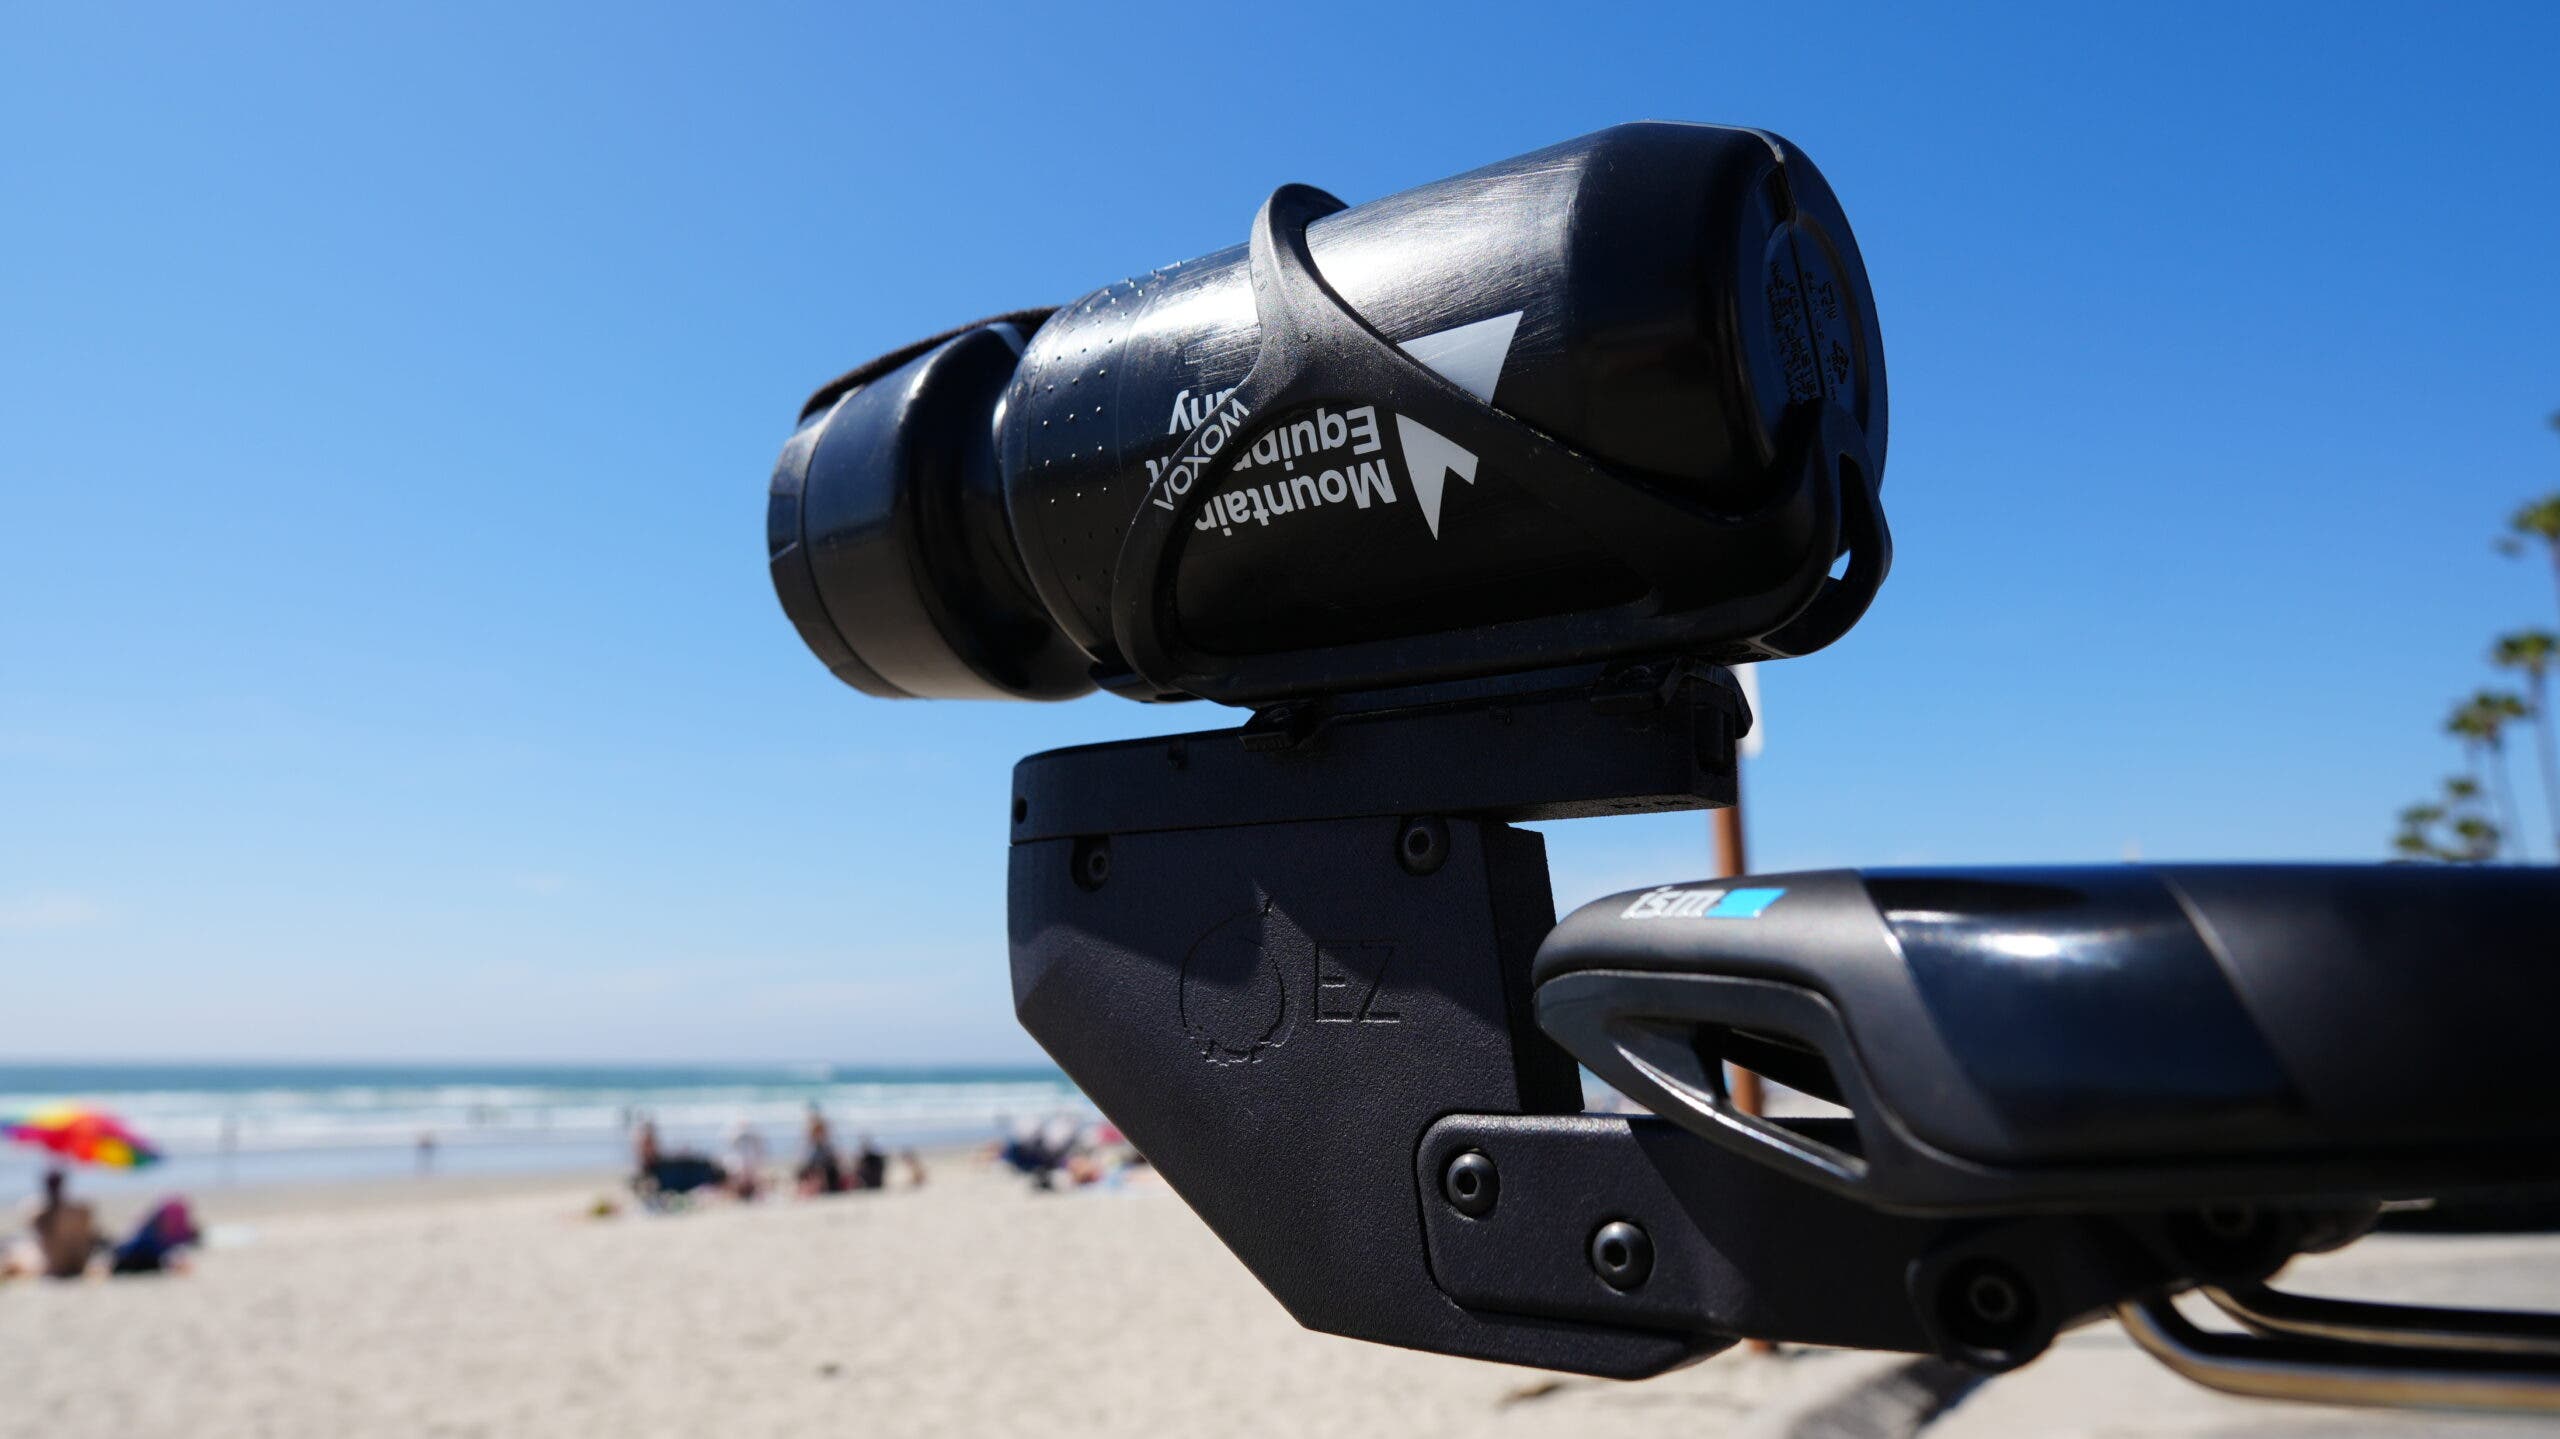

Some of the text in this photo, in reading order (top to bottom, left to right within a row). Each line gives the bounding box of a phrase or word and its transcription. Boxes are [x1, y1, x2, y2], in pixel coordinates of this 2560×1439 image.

[1145, 405, 1382, 488] Equipt
[1152, 397, 1250, 511] VOXOM
[1195, 458, 1398, 537] Mountain
[1620, 886, 1727, 919] ism
[1313, 939, 1401, 1023] EZ
